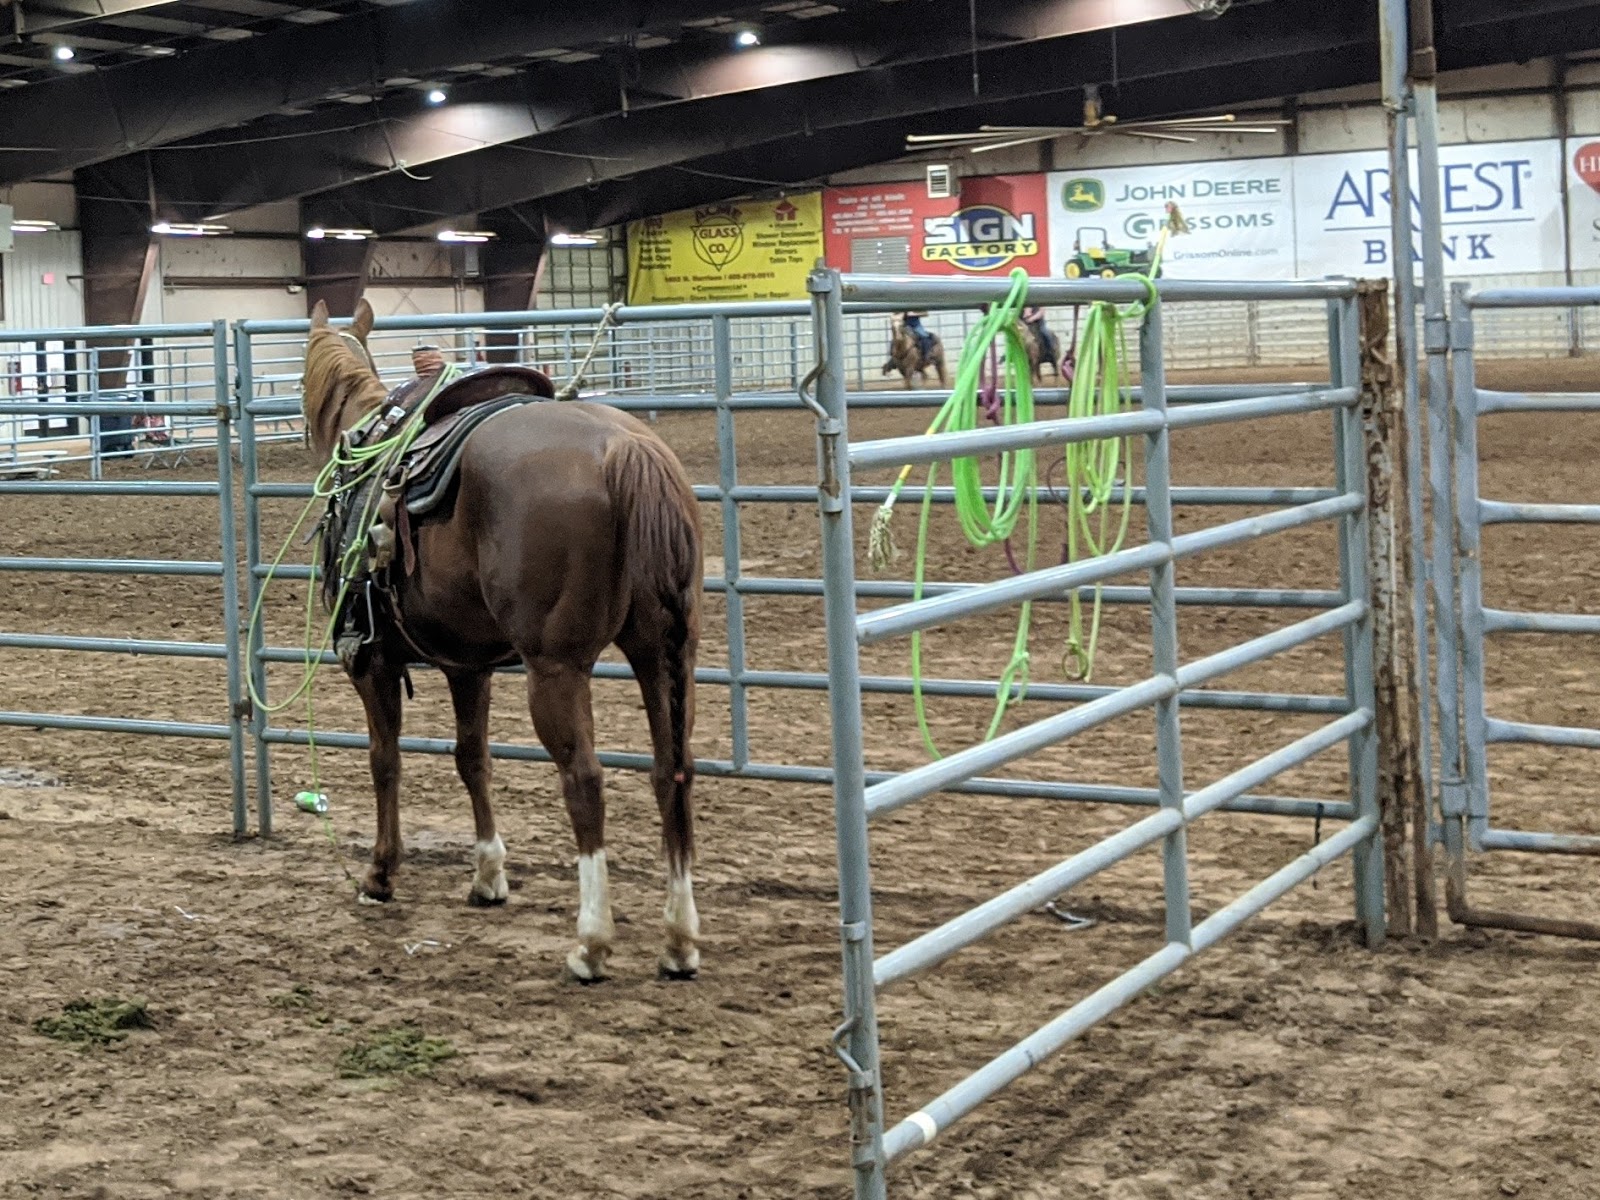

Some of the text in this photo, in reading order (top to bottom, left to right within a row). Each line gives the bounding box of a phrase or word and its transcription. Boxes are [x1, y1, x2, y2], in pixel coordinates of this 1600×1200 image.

[1115, 178, 1281, 202] JOHN DEERE
[1324, 160, 1530, 220] AREST
[700, 227, 738, 240] GLASS
[924, 213, 1034, 245] SIGN
[708, 243, 729, 254] CO.
[926, 243, 1033, 258] FACTORY
[1363, 233, 1495, 265] BNK
